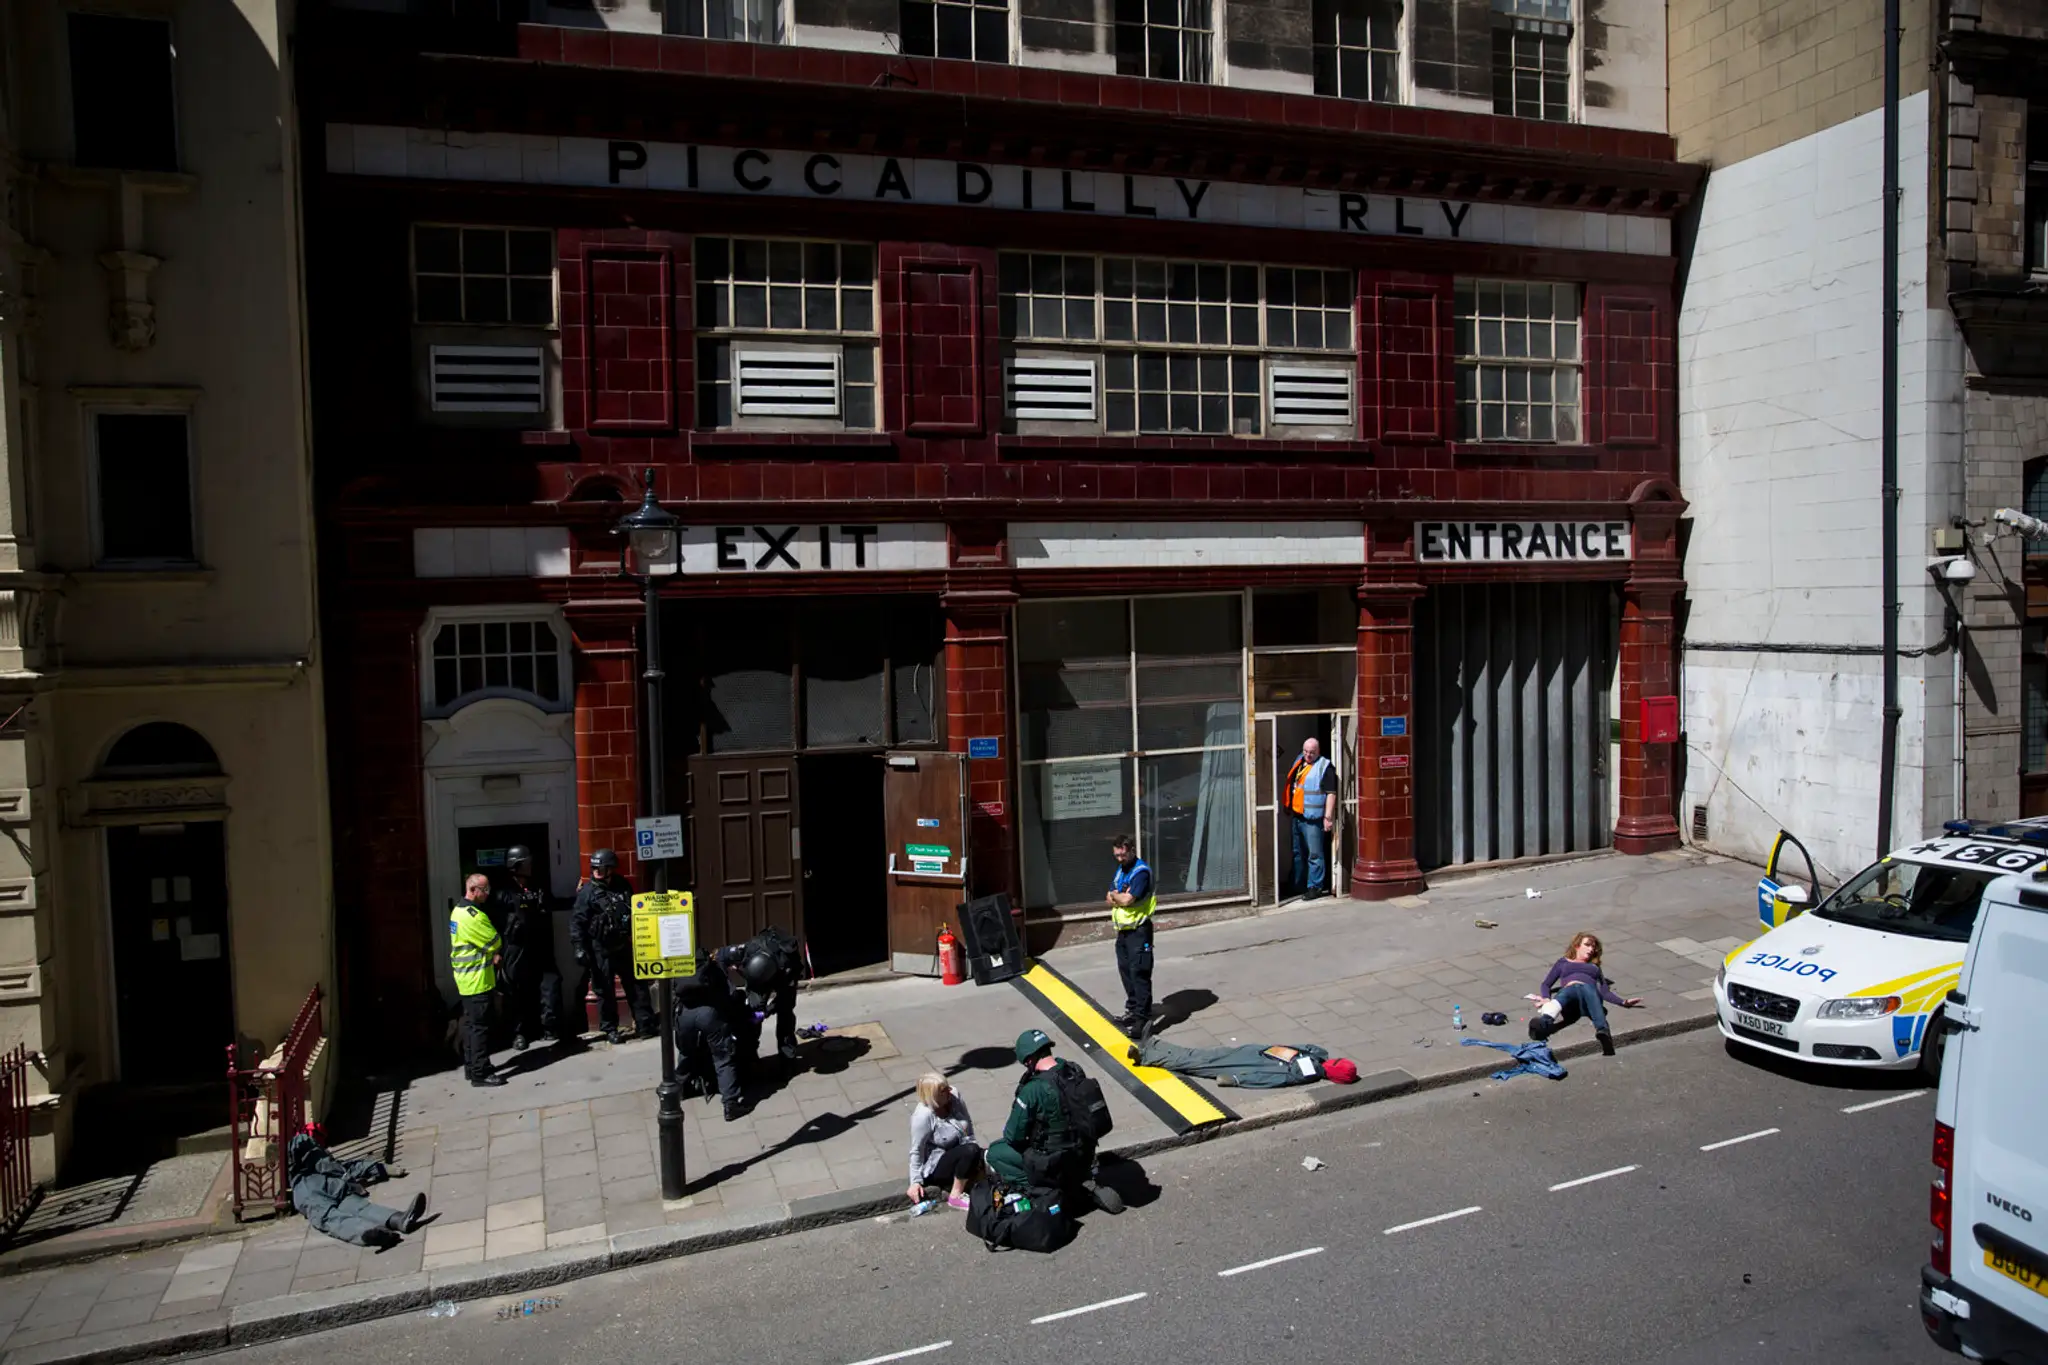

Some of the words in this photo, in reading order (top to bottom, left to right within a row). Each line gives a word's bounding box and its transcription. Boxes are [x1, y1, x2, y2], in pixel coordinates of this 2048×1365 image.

[608, 140, 1210, 219] PICCADILLY
[1339, 193, 1470, 238] RLY
[715, 525, 878, 570] EXIT
[1421, 523, 1625, 560] ENTRANCE
[641, 831, 651, 845] P
[644, 893, 680, 902] WARNING
[636, 961, 664, 976] NO
[1762, 1020, 1784, 1036] DRZ
[1986, 1191, 2033, 1222] IVECO
